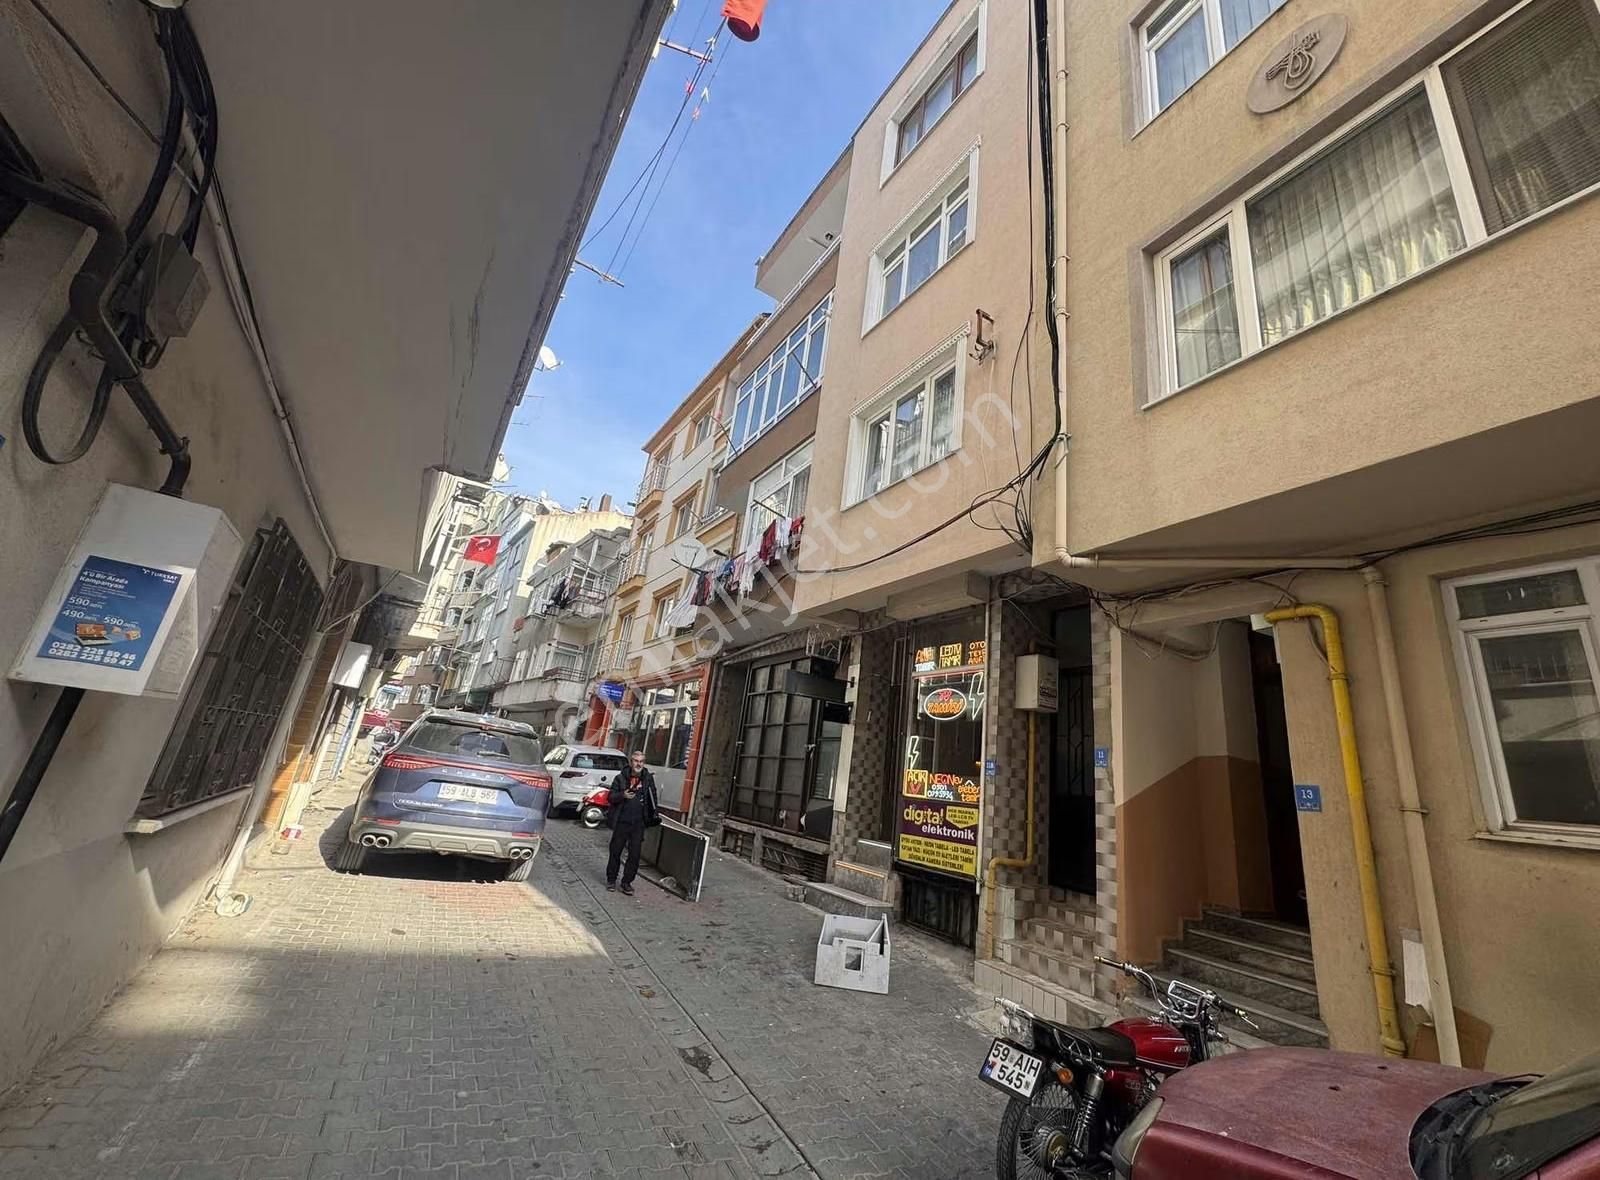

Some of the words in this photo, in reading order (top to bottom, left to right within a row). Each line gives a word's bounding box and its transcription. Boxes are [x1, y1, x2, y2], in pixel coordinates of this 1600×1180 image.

[106, 574, 128, 586] Arada
[68, 596, 90, 607] 590
[62, 610, 85, 620] 490
[103, 616, 124, 627] 590
[52, 641, 82, 652] 0282
[83, 646, 104, 656] 225
[969, 641, 986, 650] OTO
[48, 648, 77, 659] 0282
[80, 652, 101, 662] 225
[103, 655, 118, 665] 59
[120, 658, 134, 667] 47
[908, 771, 926, 784] AÇIK
[929, 773, 955, 786] NEON
[446, 785, 457, 796] 59
[1301, 789, 1313, 799] 13
[903, 804, 944, 825] digital
[922, 825, 975, 841] elektronik
[992, 1043, 1011, 1062] 59
[1013, 1053, 1041, 1078] AIH
[997, 1064, 1026, 1089] 545
